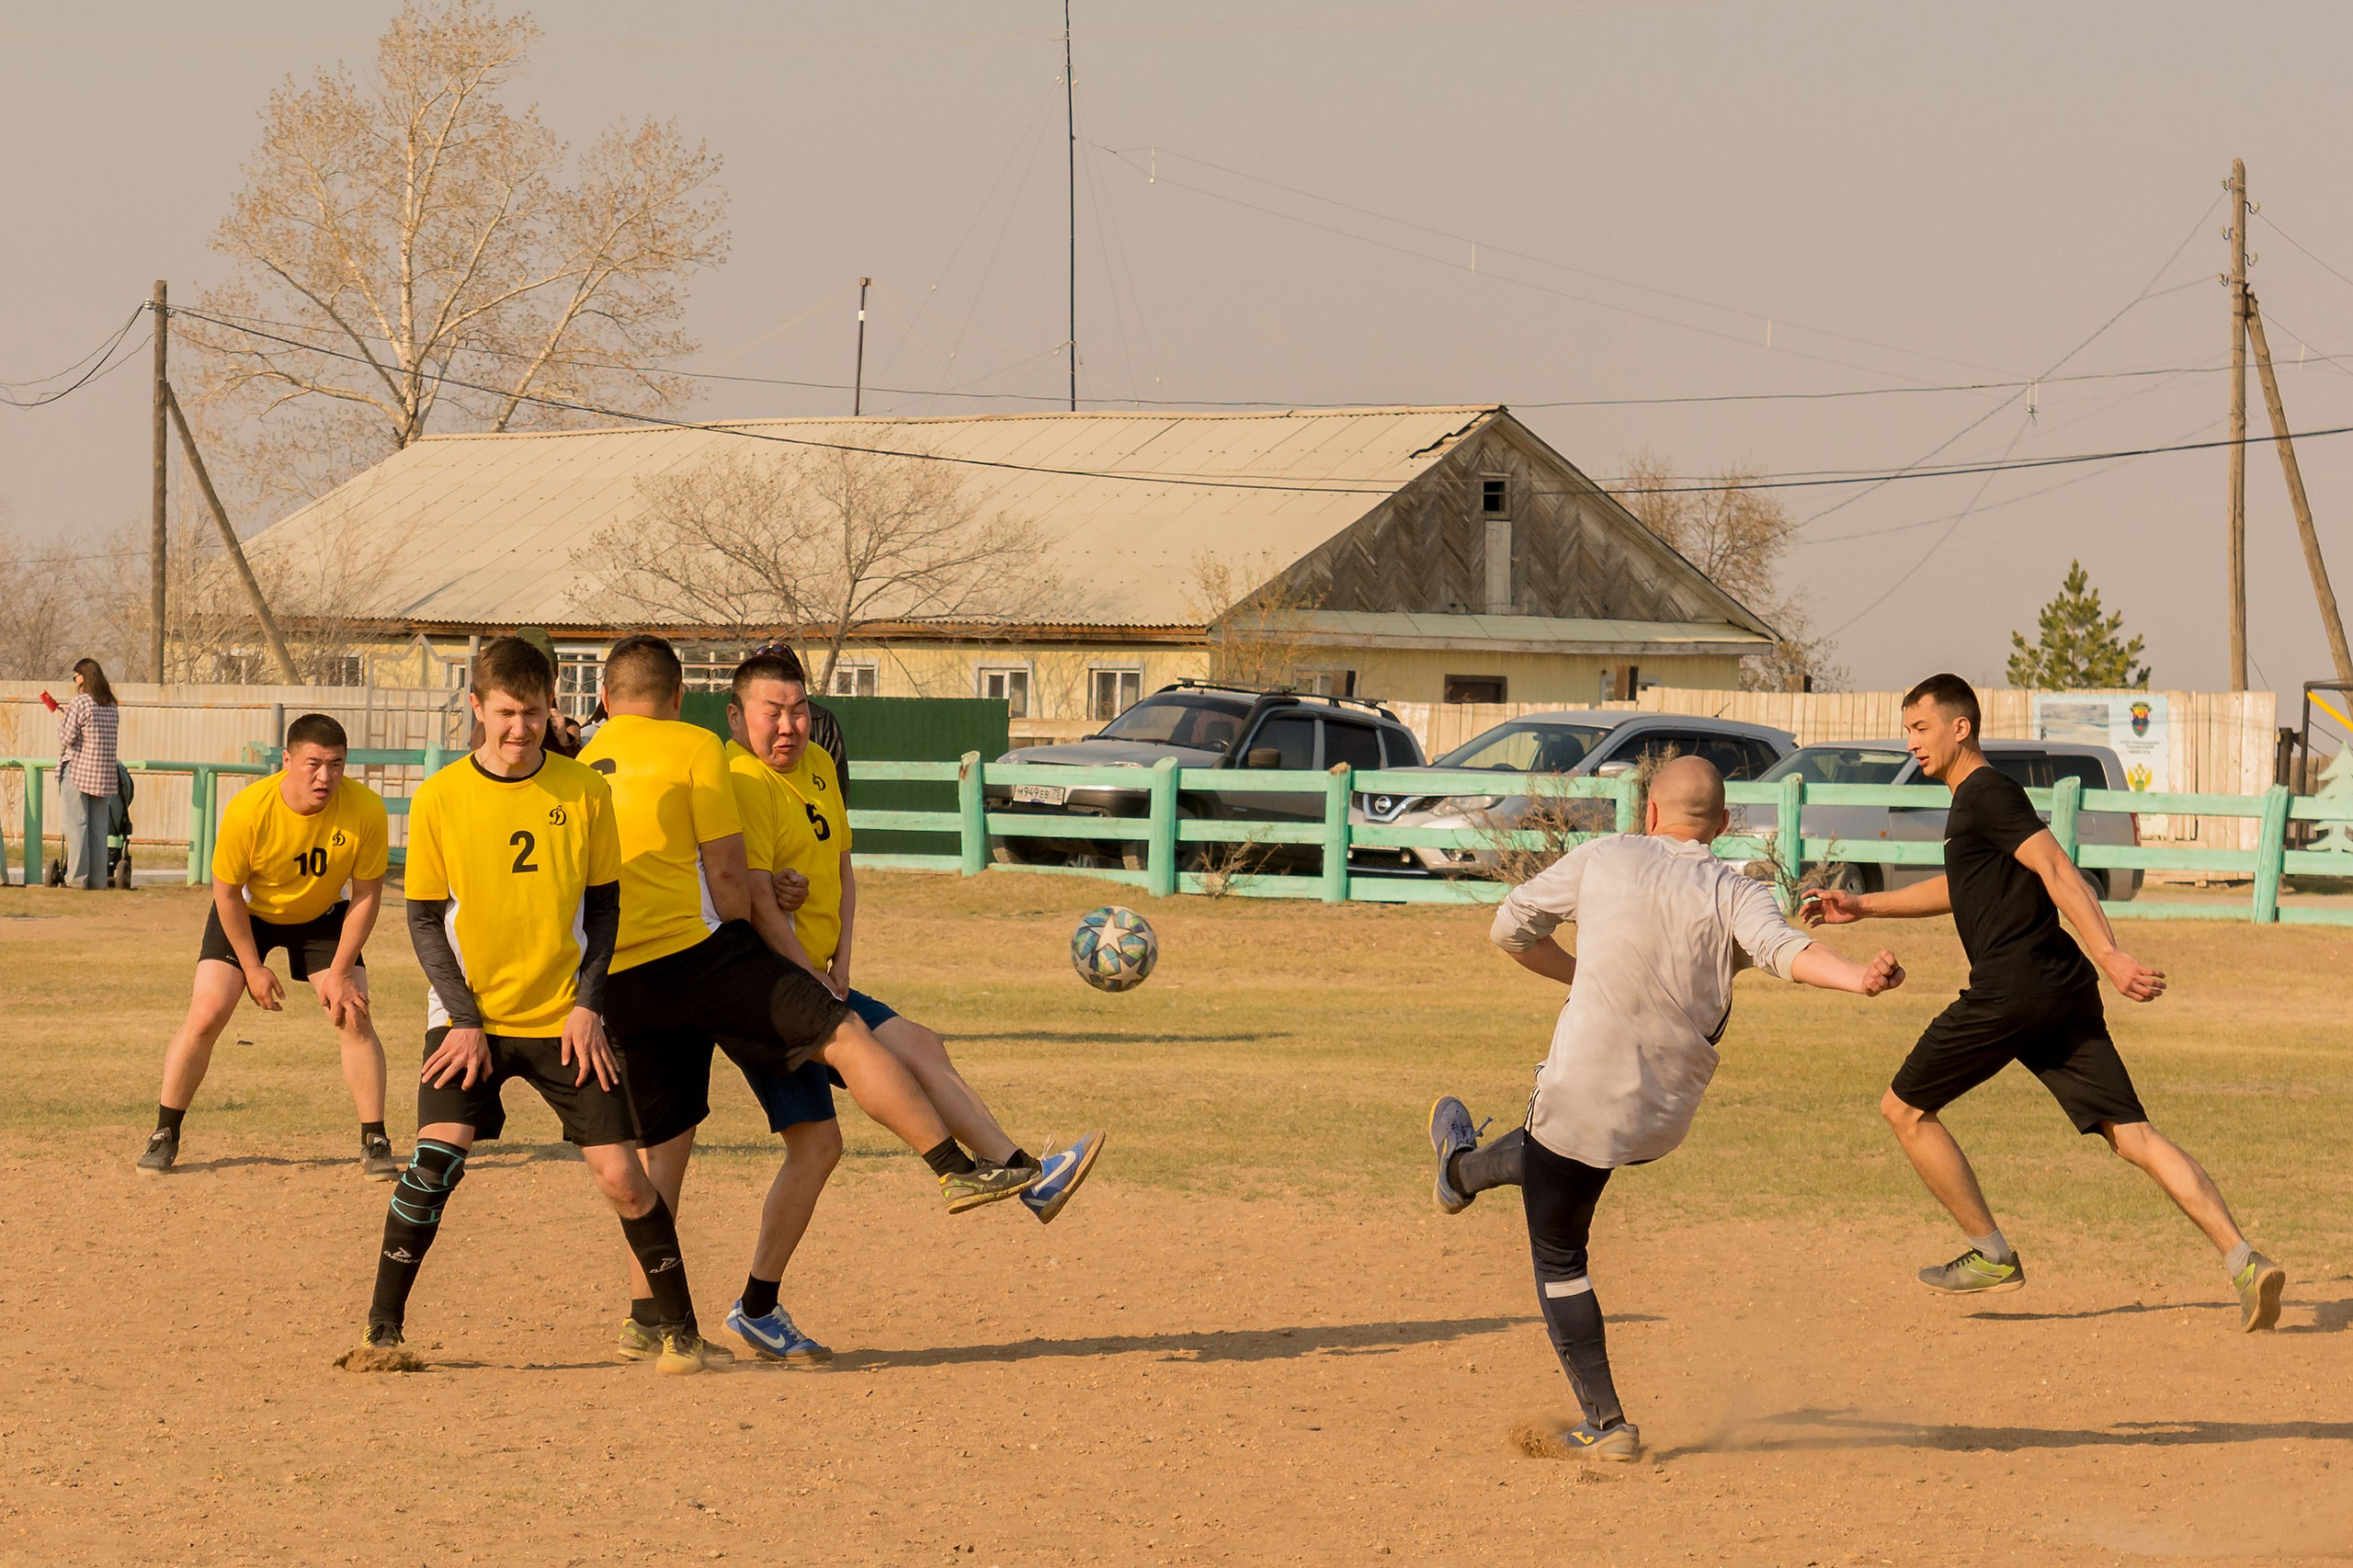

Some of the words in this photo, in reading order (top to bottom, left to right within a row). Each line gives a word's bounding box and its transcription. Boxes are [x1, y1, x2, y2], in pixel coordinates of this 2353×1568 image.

[805, 802, 831, 841] 5
[293, 846, 327, 878] 10
[509, 830, 539, 873] 2
